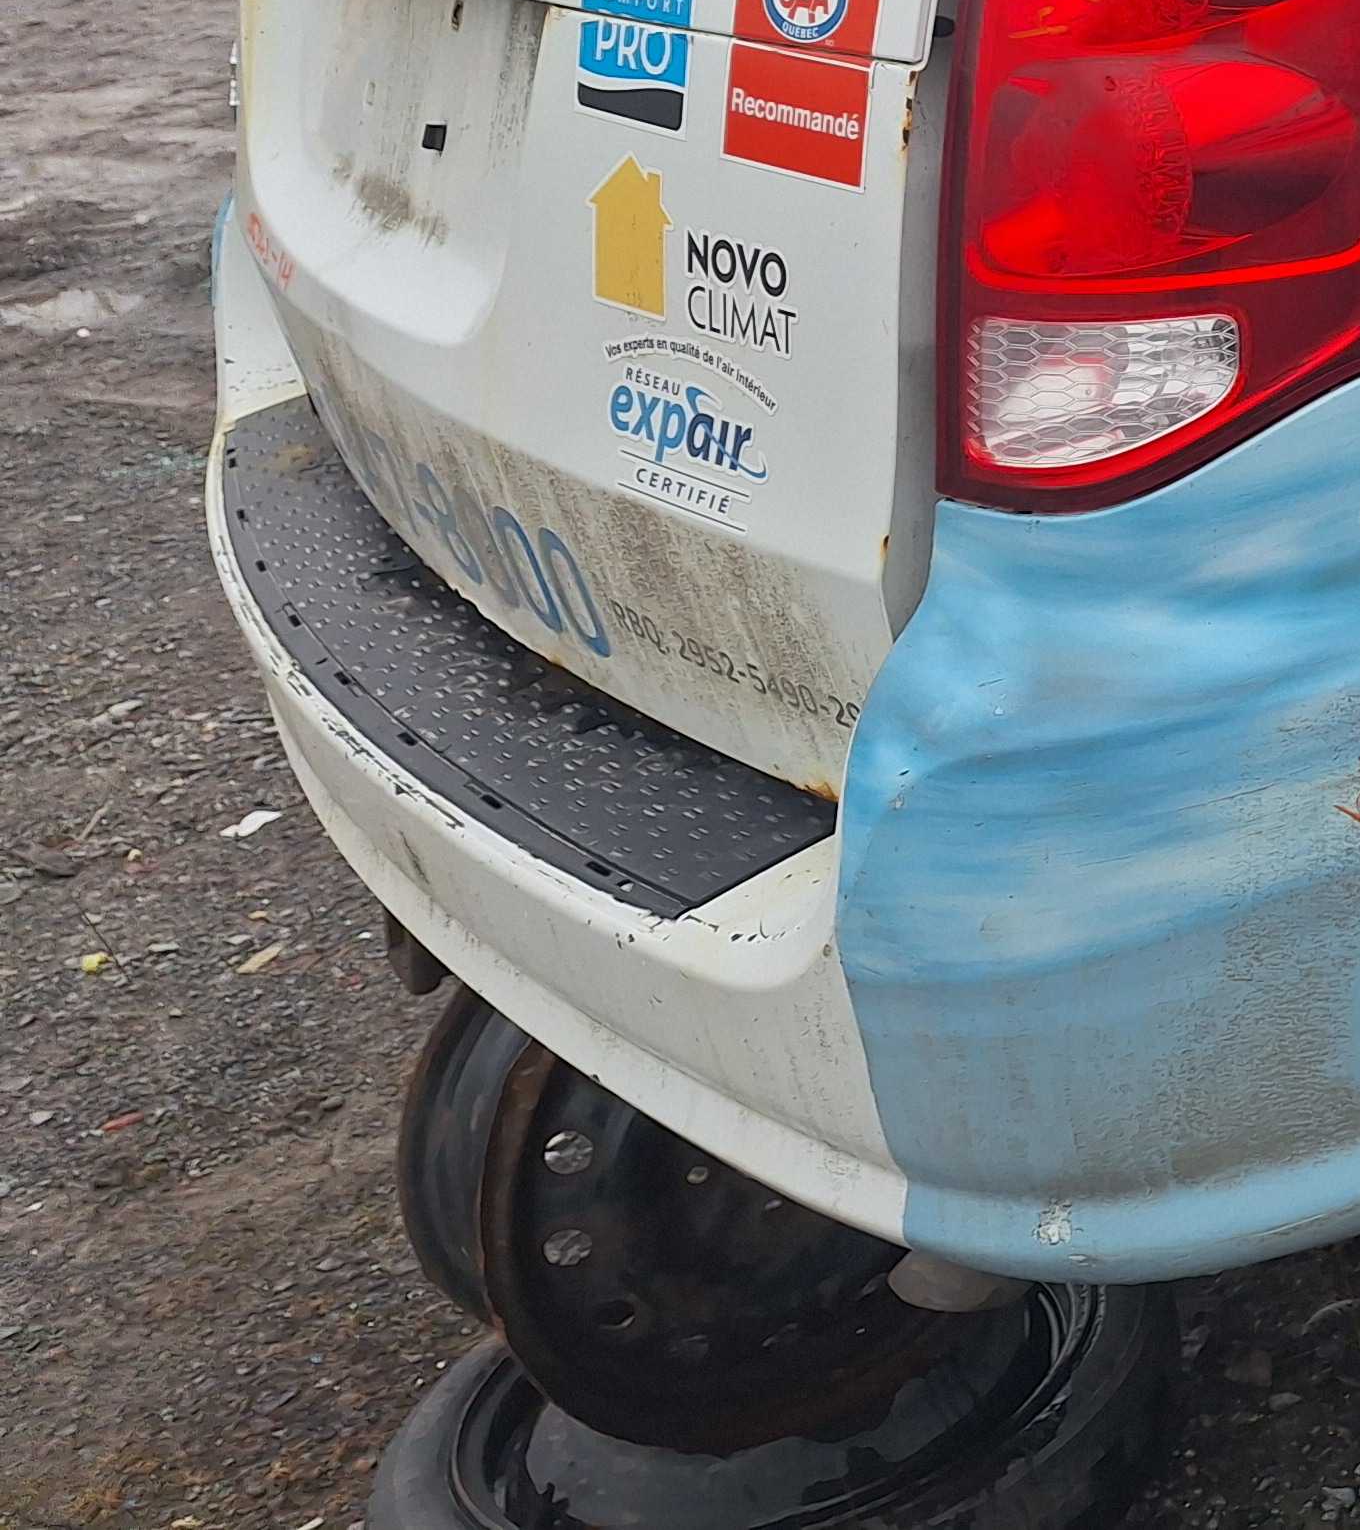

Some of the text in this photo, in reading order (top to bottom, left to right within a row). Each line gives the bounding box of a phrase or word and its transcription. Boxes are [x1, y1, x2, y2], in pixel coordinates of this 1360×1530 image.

[594, 9, 672, 76] PRO
[731, 87, 860, 141] Recommandé
[687, 229, 787, 298] NOVO
[687, 285, 797, 354] CLIMAT
[605, 336, 777, 412] Vos experts en qualité de l'air intérieur
[625, 366, 681, 397] RÉSEAU
[610, 385, 754, 472] expair
[636, 468, 732, 515] CERTIFIÉ
